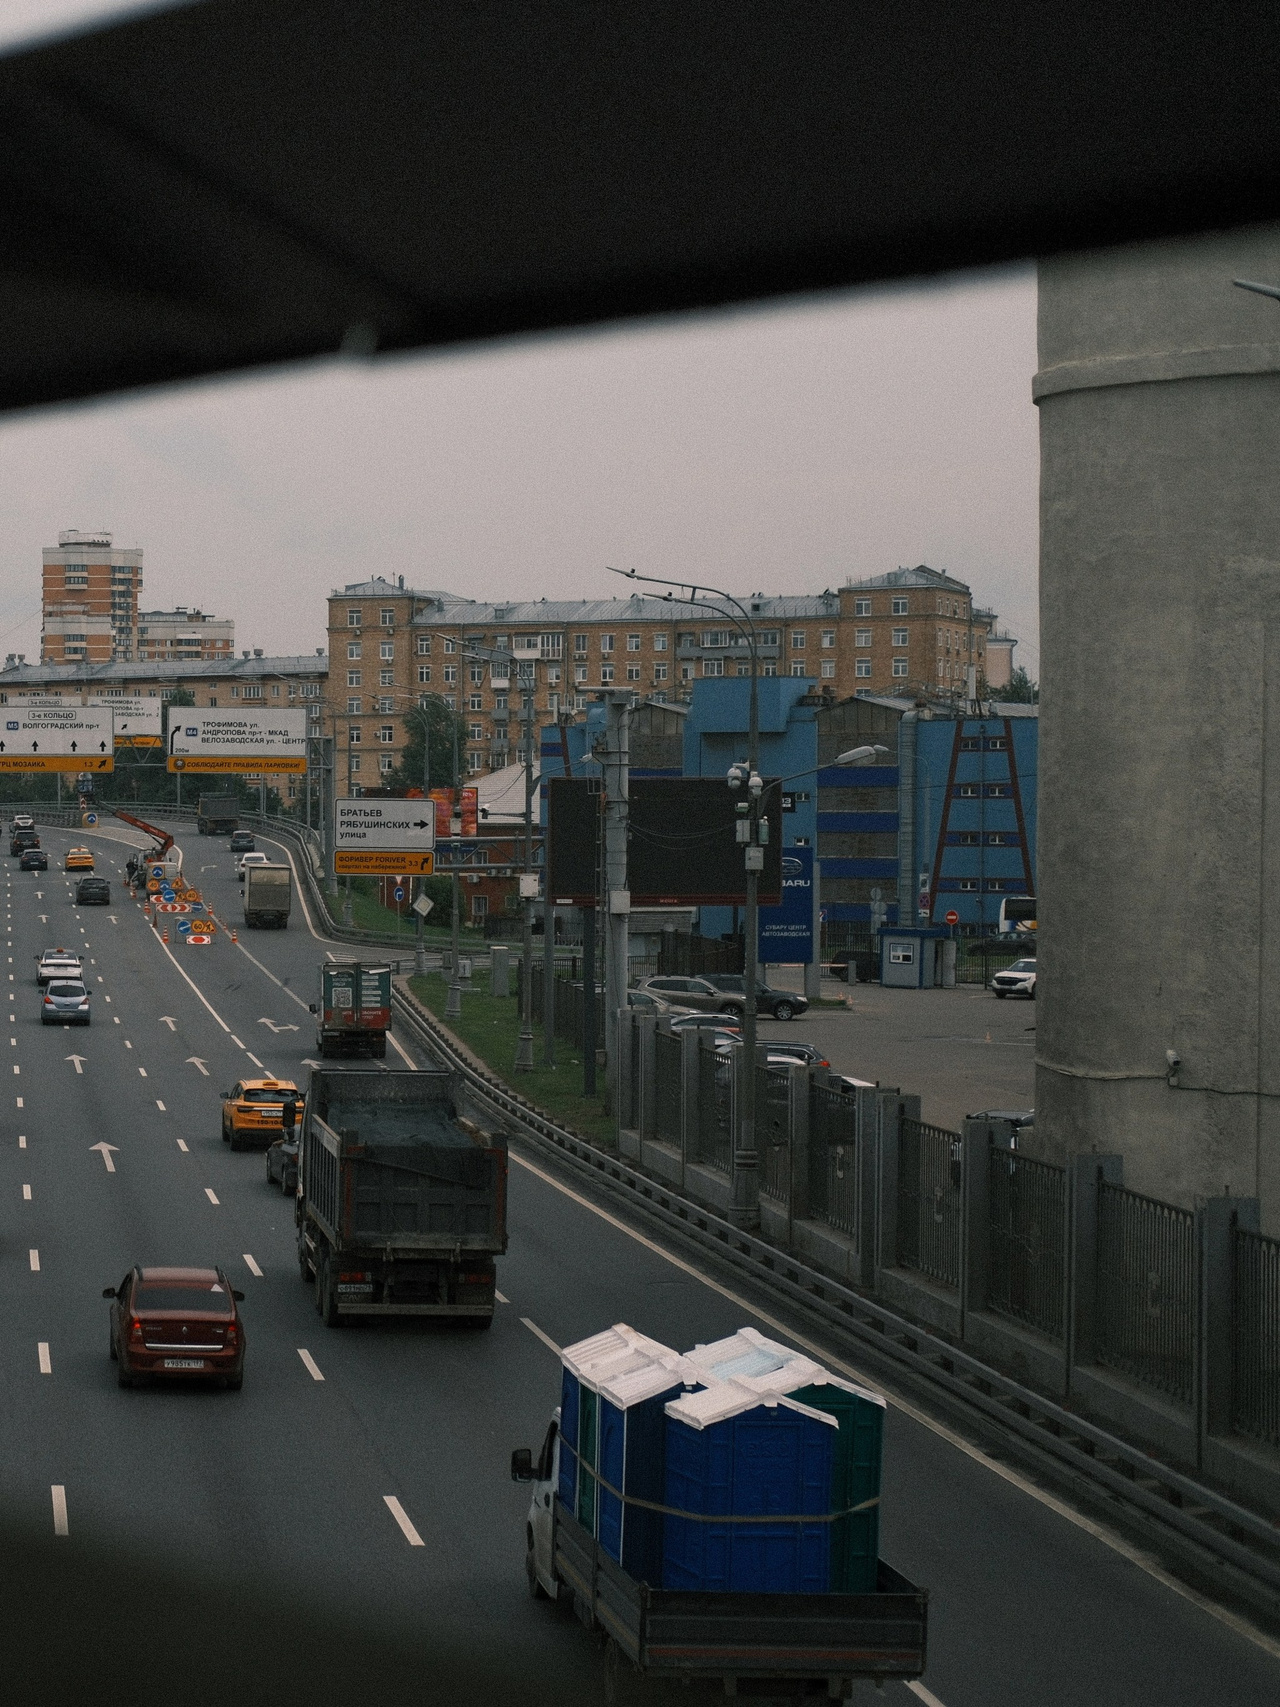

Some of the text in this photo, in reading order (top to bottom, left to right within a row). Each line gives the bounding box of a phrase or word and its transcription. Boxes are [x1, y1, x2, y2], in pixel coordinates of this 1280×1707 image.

[43, 712, 74, 720] КОЛЬЦО
[22, 721, 84, 730] ВОЛГОГРАДСКИЙ
[340, 821, 411, 829] РЯБУШИНСКИХ
[339, 832, 367, 840] улица
